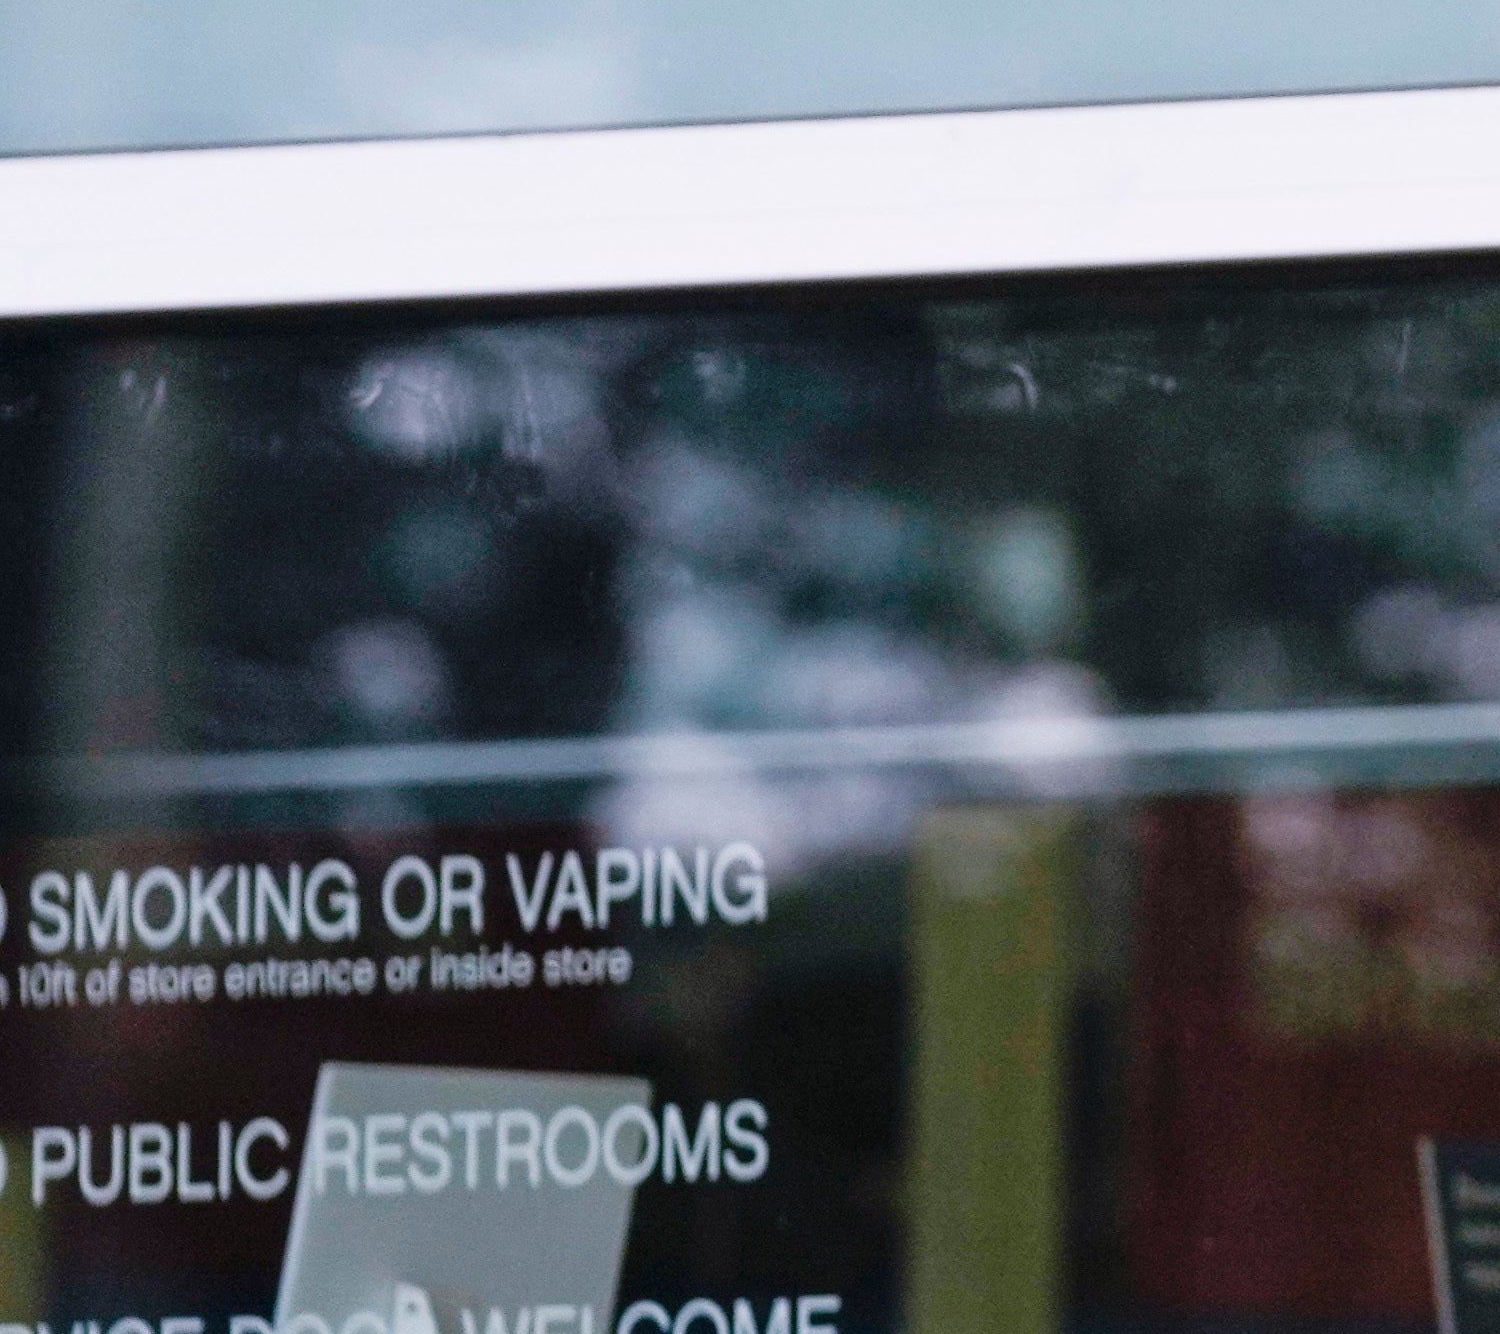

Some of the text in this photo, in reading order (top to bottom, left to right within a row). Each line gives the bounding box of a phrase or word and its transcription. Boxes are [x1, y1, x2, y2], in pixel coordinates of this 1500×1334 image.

[28, 857, 361, 954] SMOKING
[380, 853, 485, 940] OR
[505, 840, 770, 934] VAPING
[18, 958, 76, 1008] 10ft
[84, 957, 122, 1006] of
[129, 962, 216, 1007] store
[223, 956, 377, 1001] entrance
[385, 954, 422, 994] or
[430, 942, 534, 990] inside
[541, 944, 634, 987] store
[32, 1115, 291, 1208] PUBLIC
[313, 1097, 770, 1197] RESTROOMS
